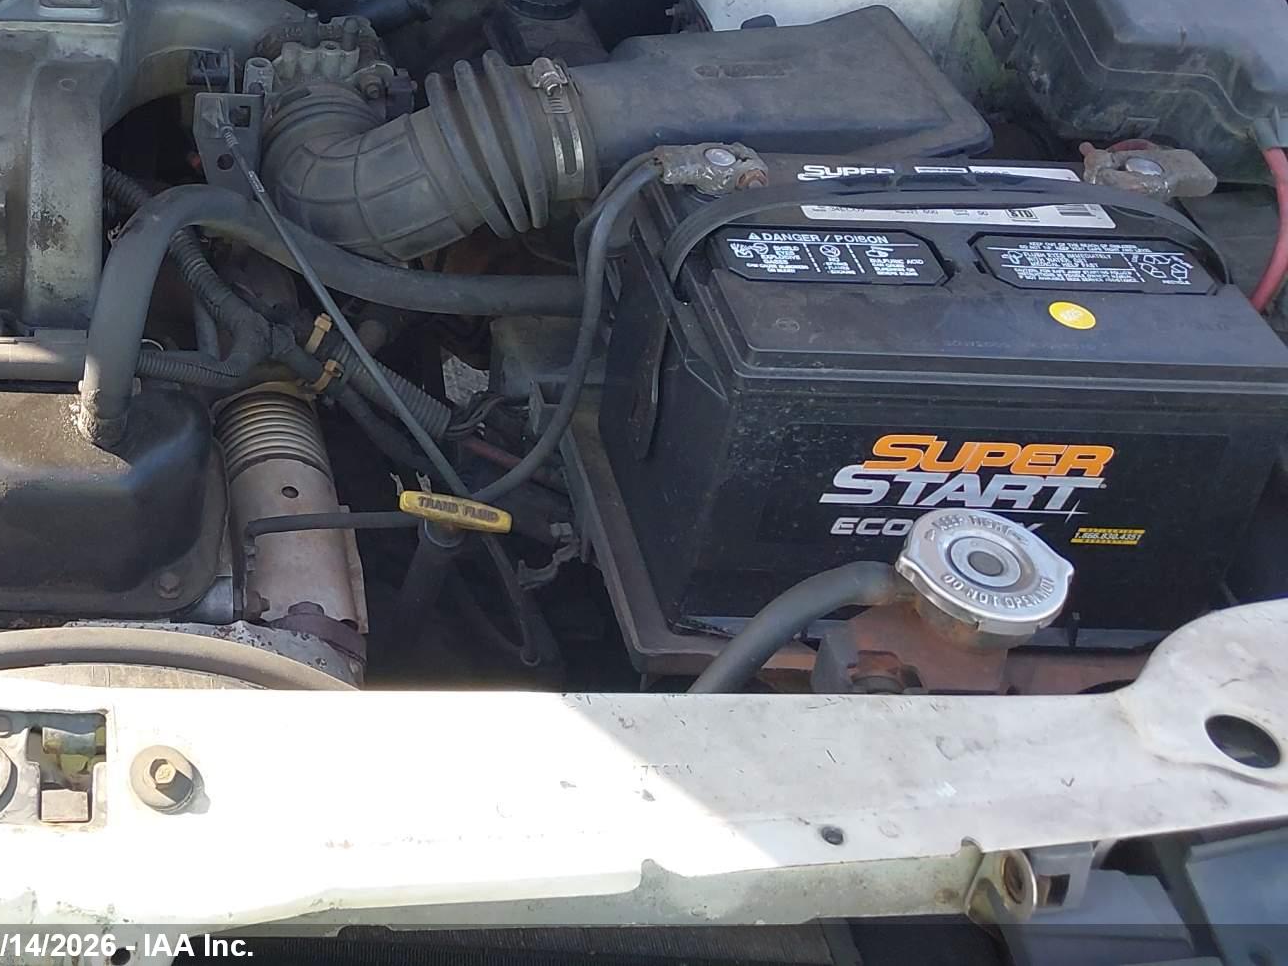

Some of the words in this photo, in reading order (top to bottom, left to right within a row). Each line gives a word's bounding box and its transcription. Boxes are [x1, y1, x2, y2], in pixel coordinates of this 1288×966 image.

[761, 233, 820, 242] DANGER
[834, 235, 889, 244] POISON
[862, 434, 1114, 477] SUPER
[819, 464, 1105, 510] START
[967, 589, 999, 607] NOT
[1005, 594, 1041, 609] OPEN
